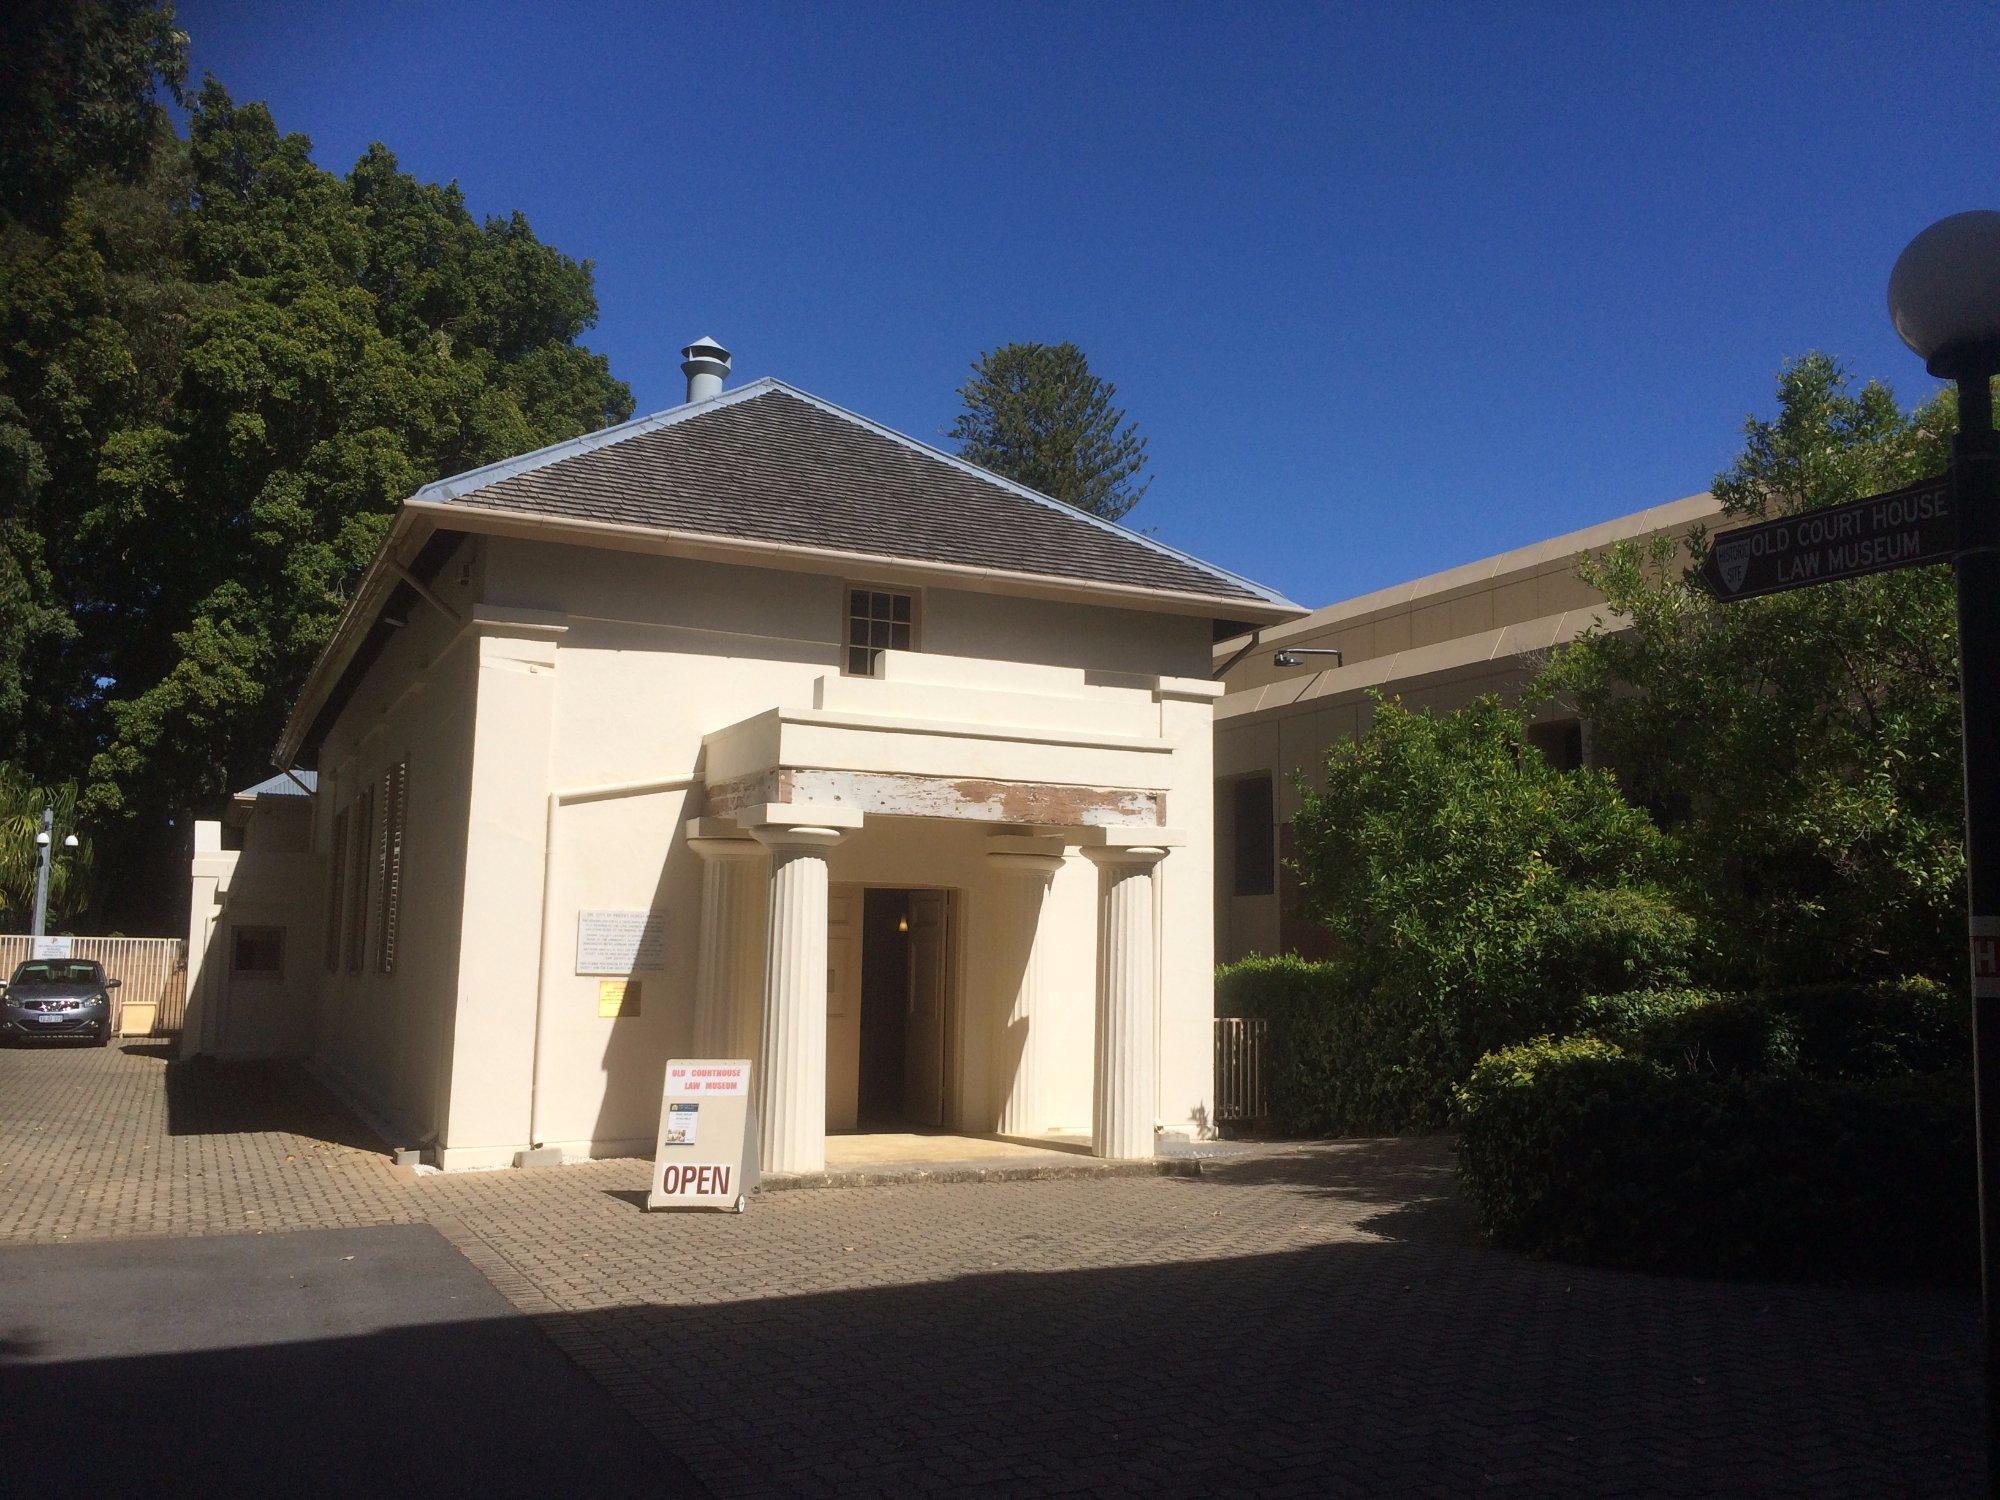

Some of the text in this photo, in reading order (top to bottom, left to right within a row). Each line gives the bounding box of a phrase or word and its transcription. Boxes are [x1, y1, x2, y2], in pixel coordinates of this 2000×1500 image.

[1751, 490, 1949, 557] OLD COURT HOUSE
[1719, 543, 1750, 563] HISTORIC
[1777, 530, 1921, 583] LAW MUSEUM
[1727, 566, 1743, 583] SITE
[672, 1068, 741, 1077] OLD COURTHOUSE
[684, 1082, 738, 1090] LAW MUSEUM
[663, 1165, 731, 1195] OPEN
